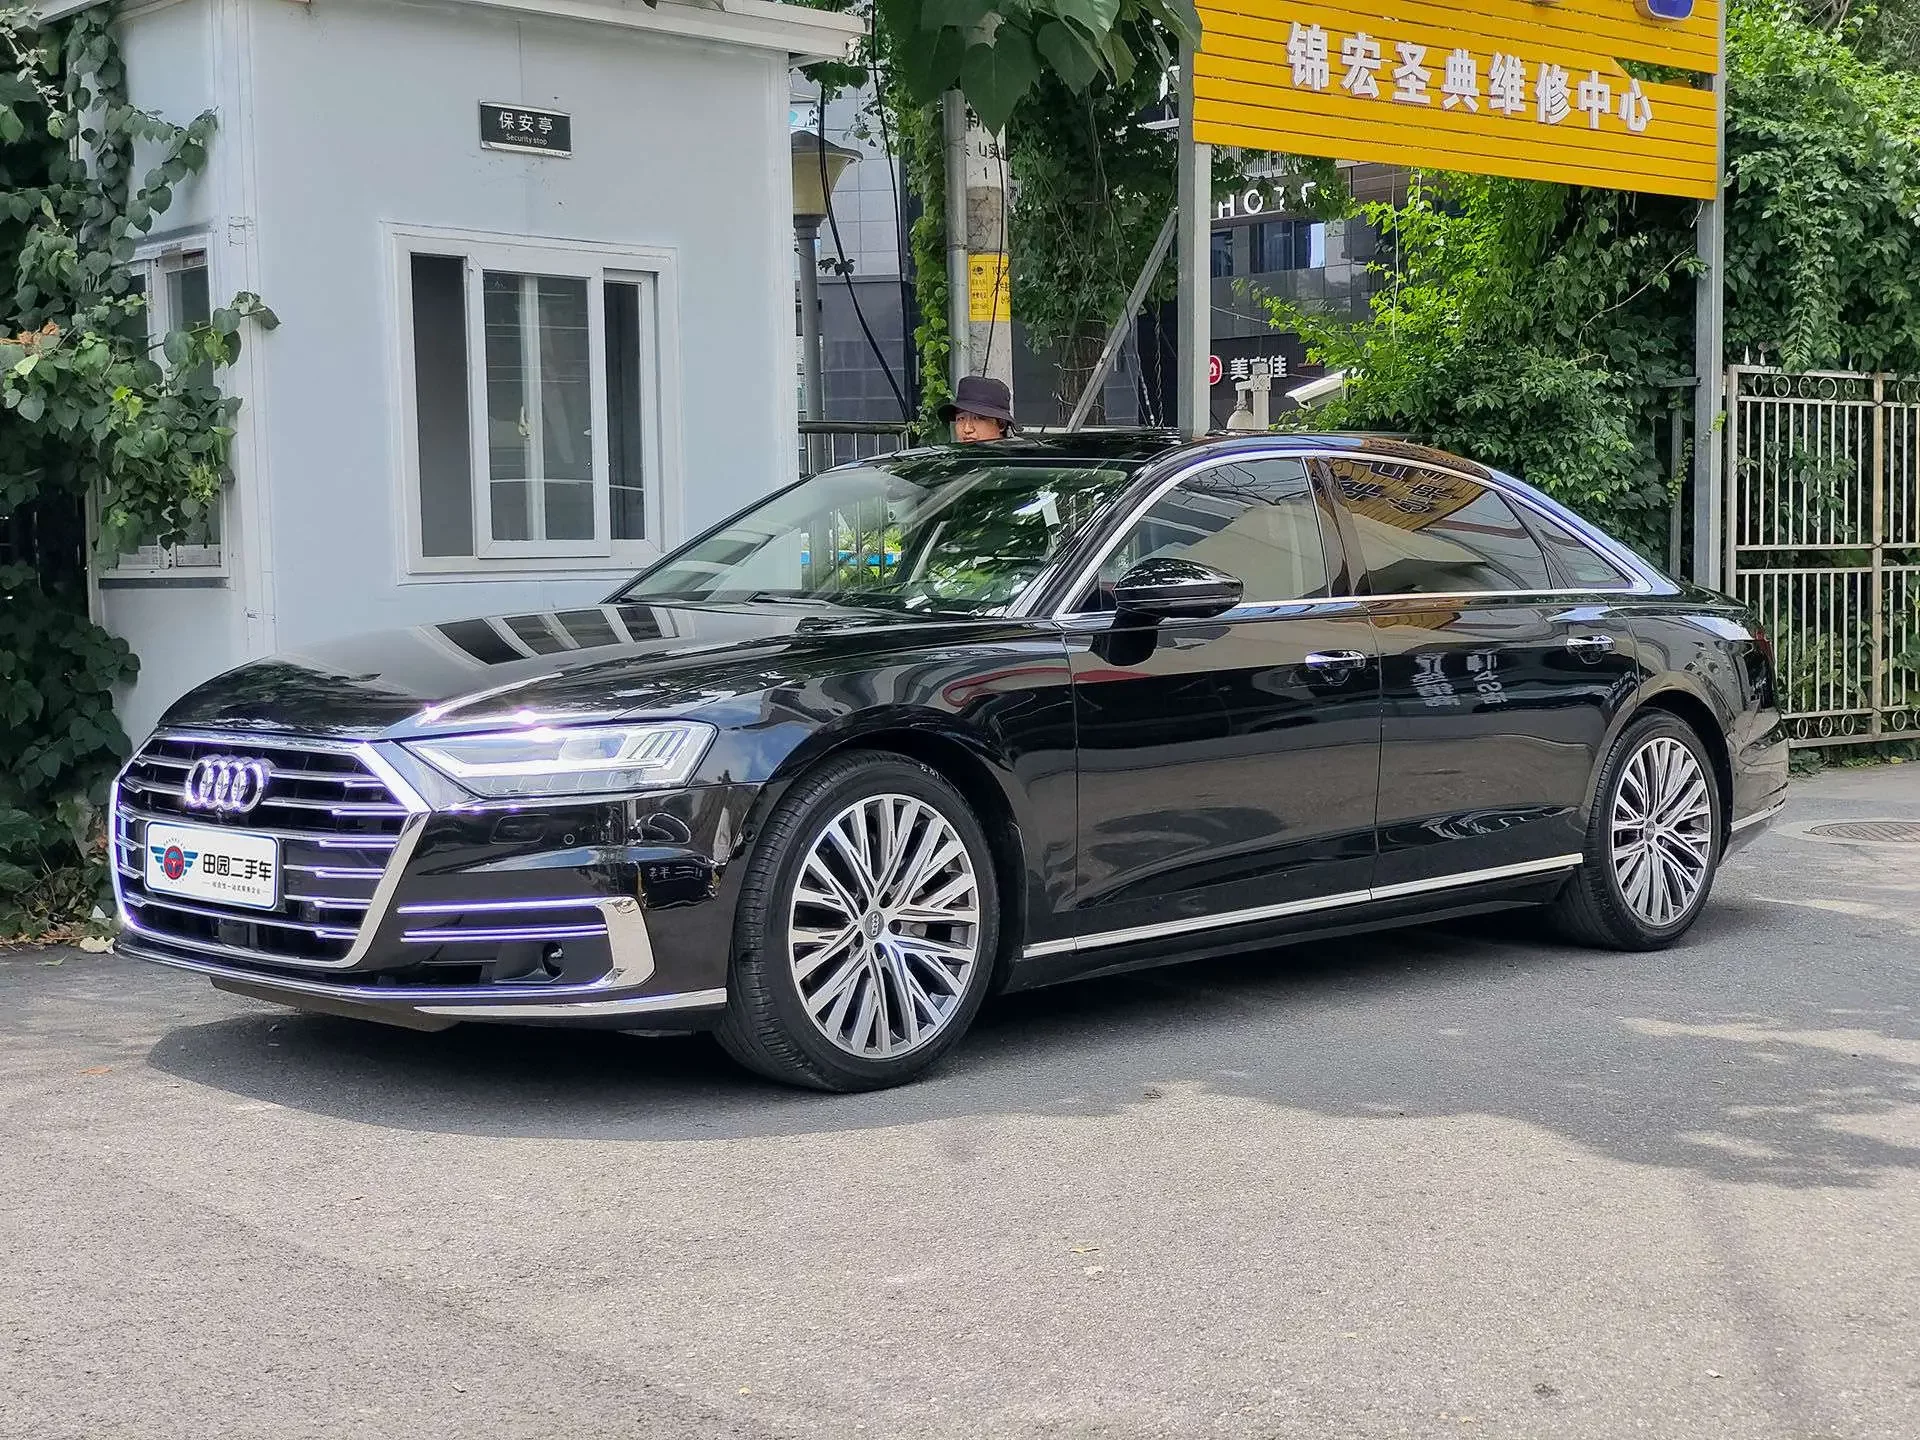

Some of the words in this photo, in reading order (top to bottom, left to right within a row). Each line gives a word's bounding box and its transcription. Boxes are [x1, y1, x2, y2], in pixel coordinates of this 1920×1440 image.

[1287, 21, 1653, 132] 锦宏圣典维修中心
[499, 110, 553, 135] 保安亭
[506, 133, 532, 144] Security
[533, 136, 548, 146] stop
[203, 853, 272, 881] 田园二手车
